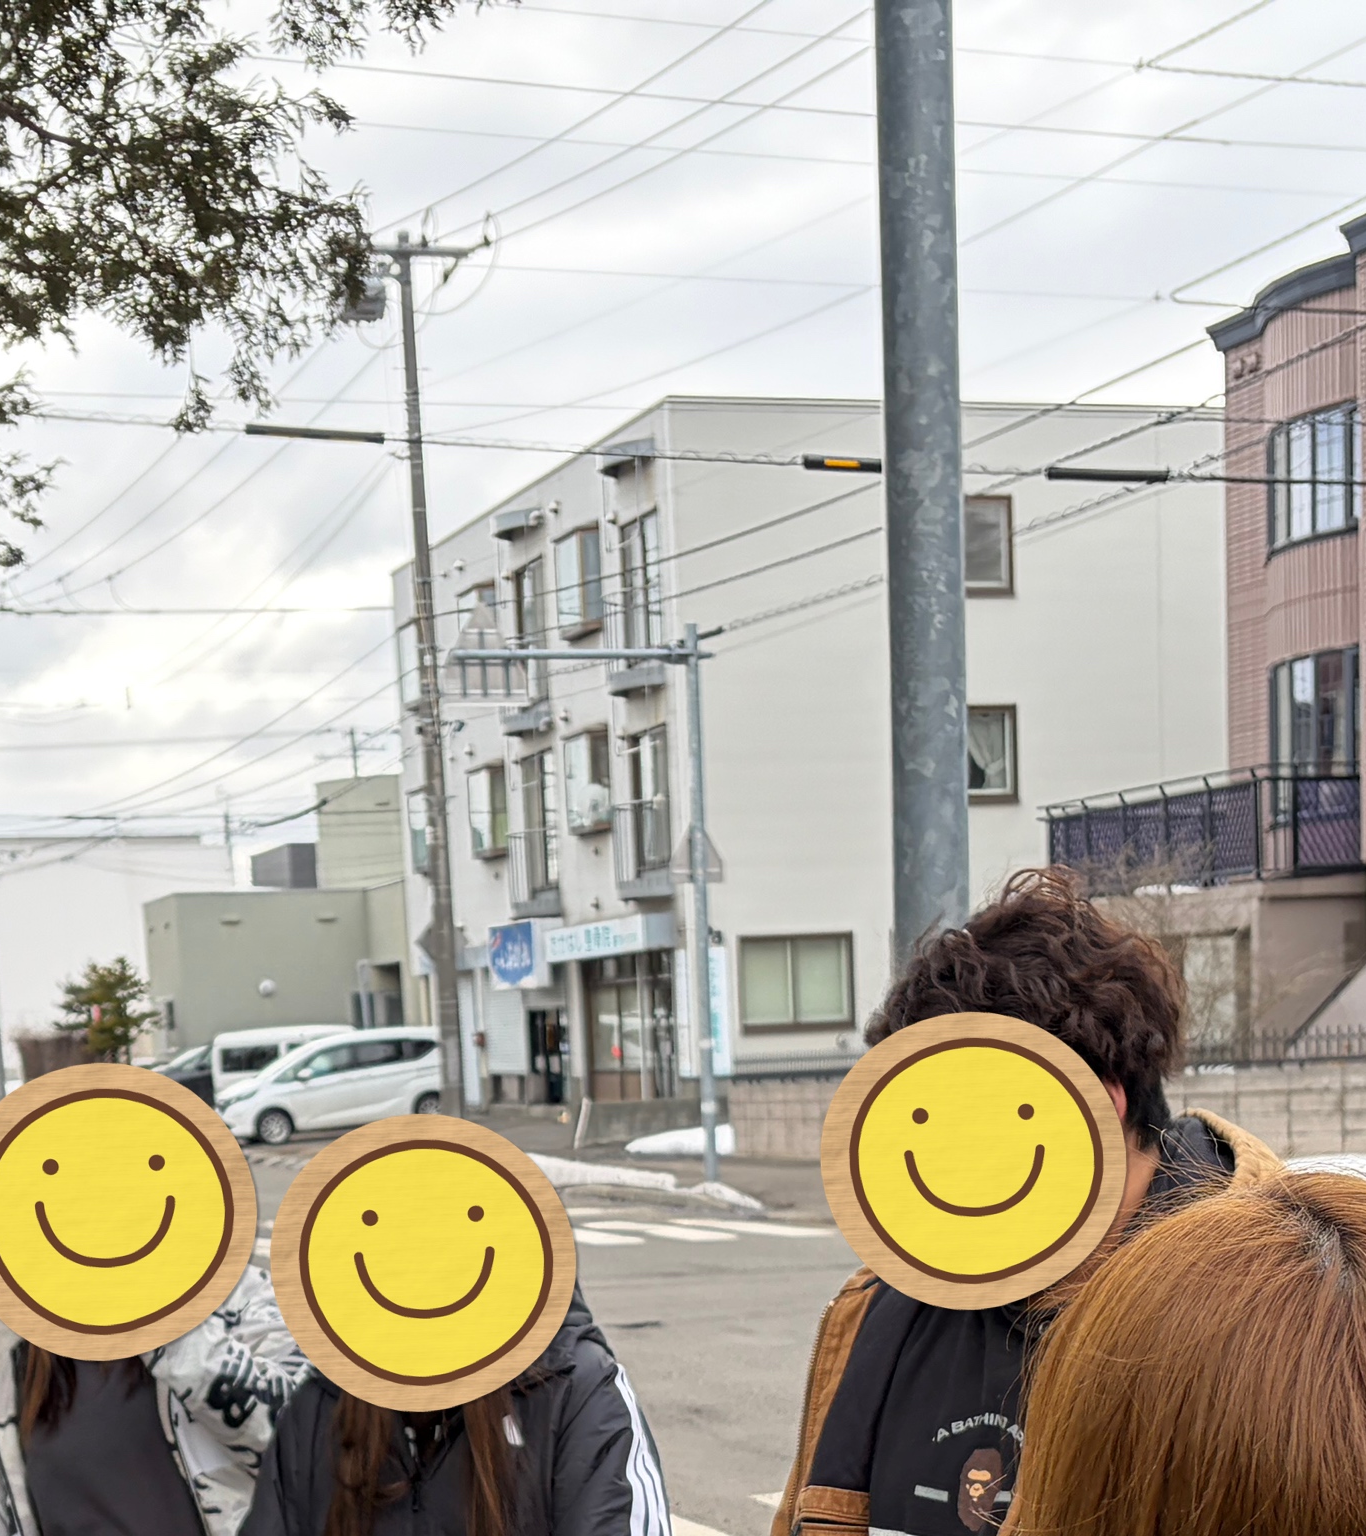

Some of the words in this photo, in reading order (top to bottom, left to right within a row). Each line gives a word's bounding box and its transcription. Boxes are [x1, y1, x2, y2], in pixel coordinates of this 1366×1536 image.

[937, 1427, 950, 1442] A
[951, 1412, 1008, 1435] BATHIN
[1007, 1424, 1024, 1448] AP
